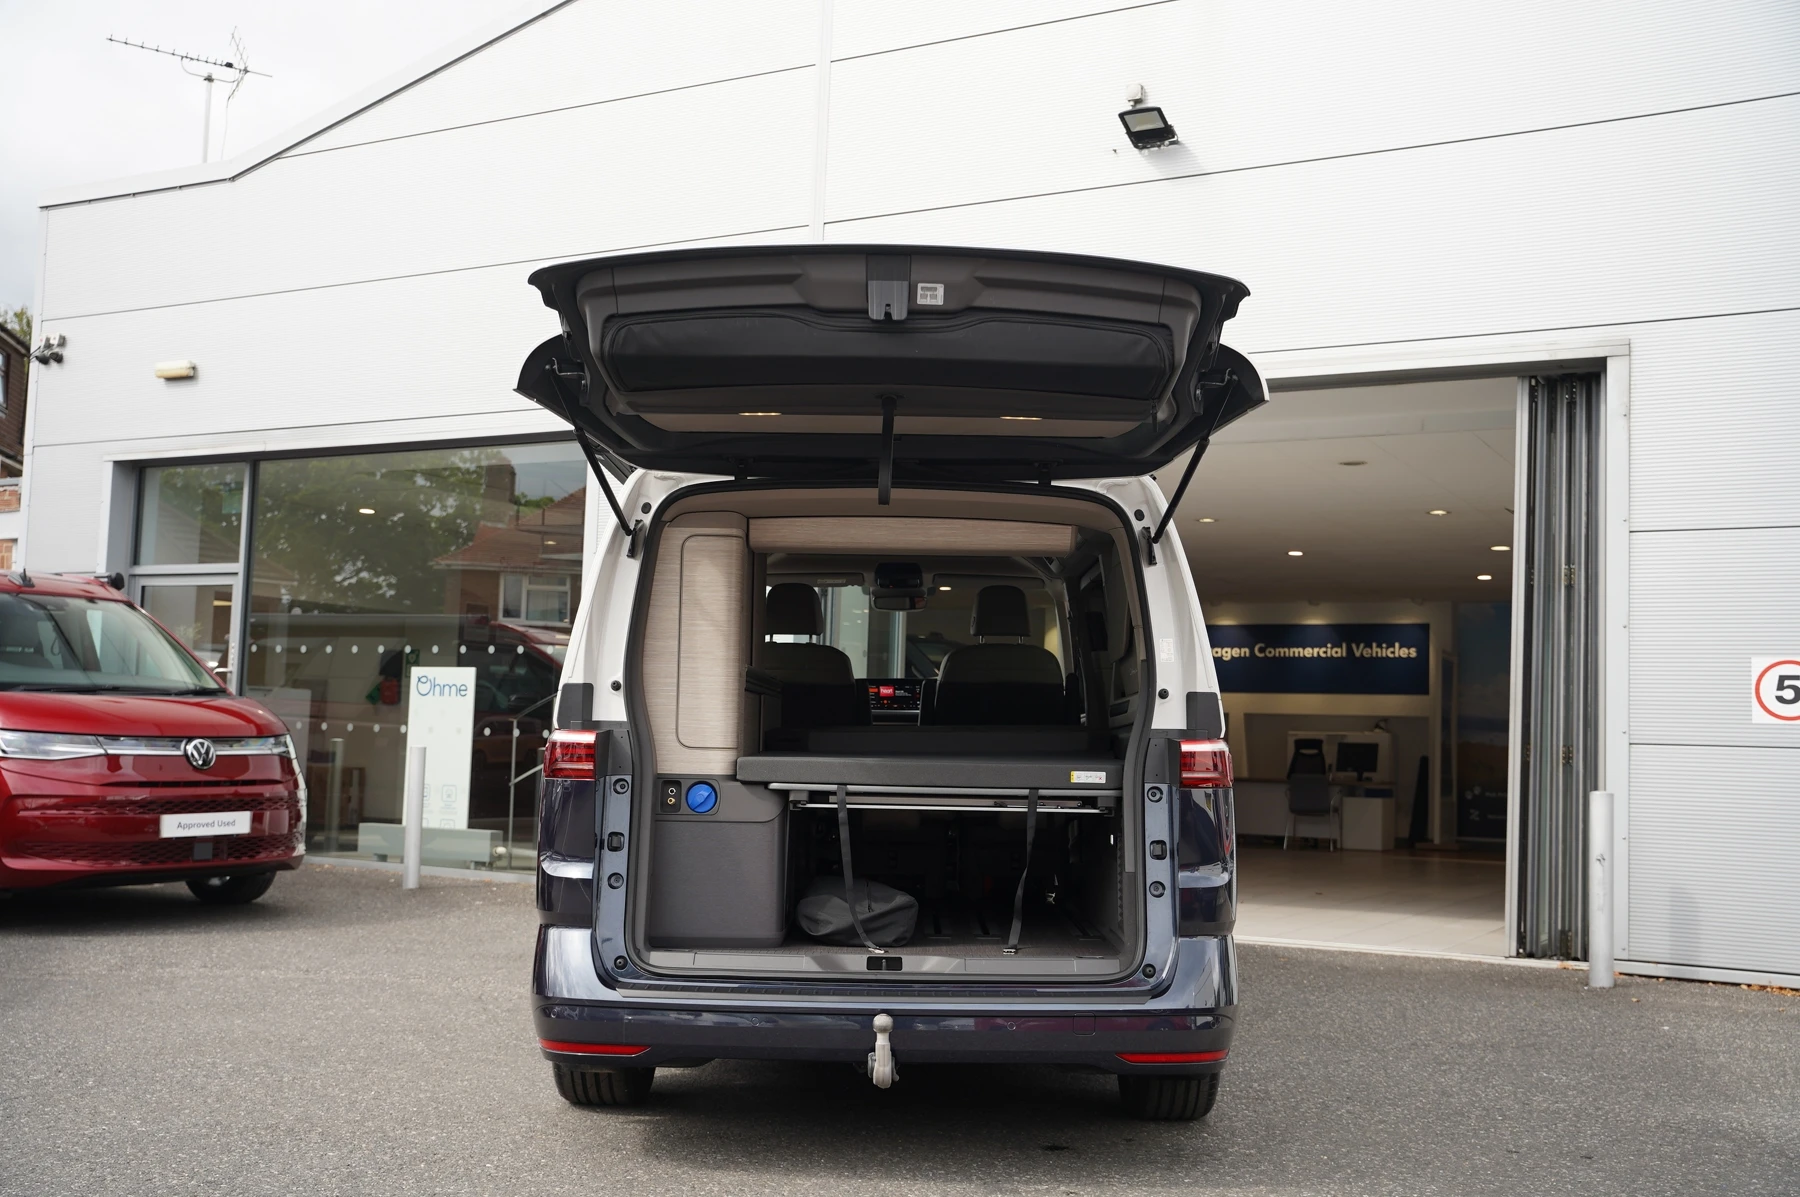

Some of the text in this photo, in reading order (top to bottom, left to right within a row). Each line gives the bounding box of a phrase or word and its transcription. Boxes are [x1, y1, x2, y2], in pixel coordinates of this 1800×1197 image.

[1212, 642, 1417, 662] agen Commercial Vehicles
[416, 675, 468, 697] Ohme
[1774, 674, 1800, 705] 5
[177, 819, 236, 831] Approved Used
